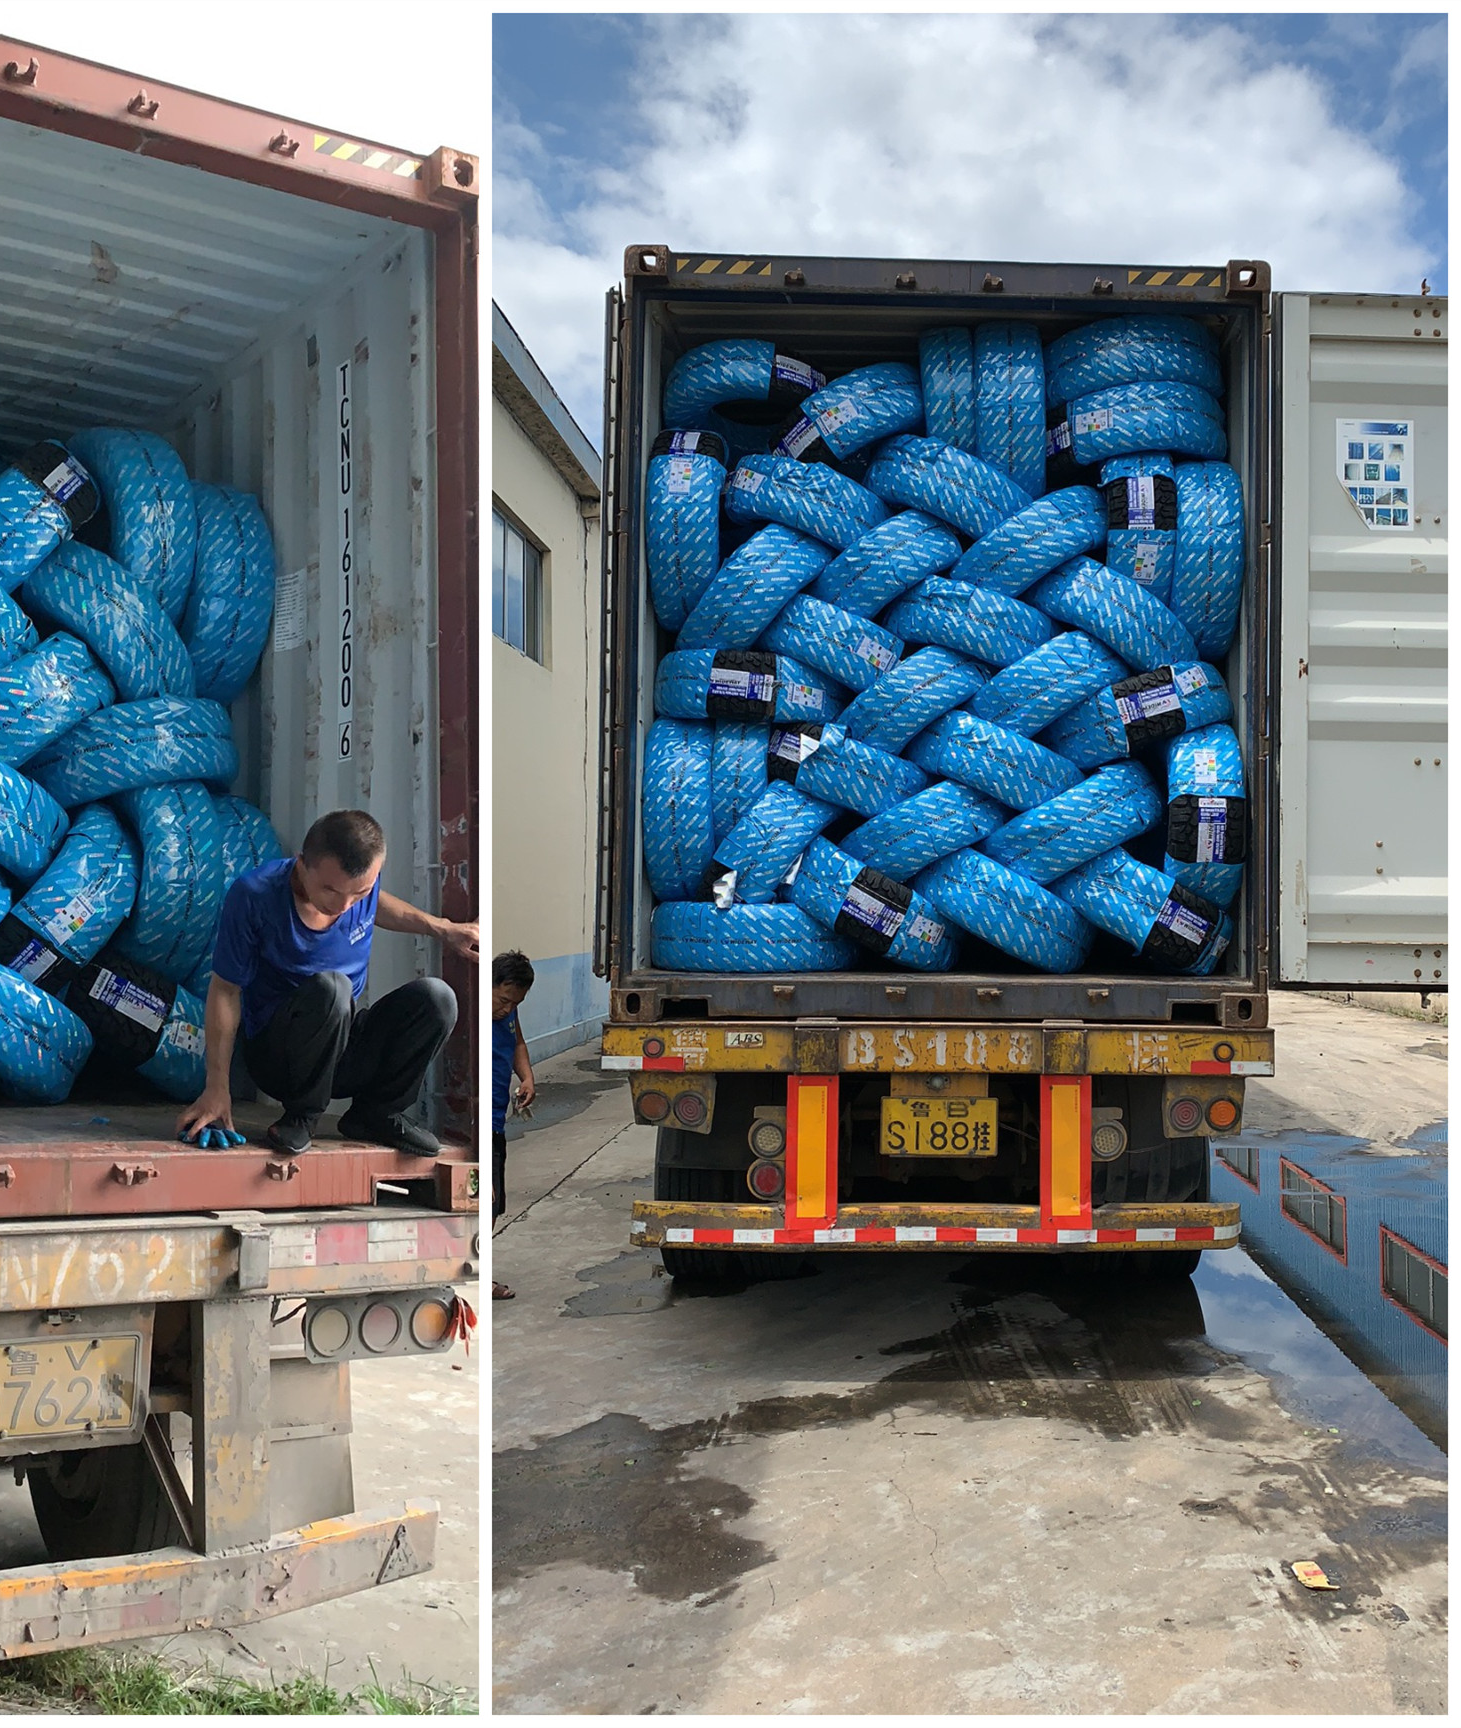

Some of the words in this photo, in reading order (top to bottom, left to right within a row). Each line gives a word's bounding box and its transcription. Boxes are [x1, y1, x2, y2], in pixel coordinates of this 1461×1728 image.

[340, 365, 350, 495] TCNU
[341, 508, 352, 709] 161200
[340, 724, 351, 757] 6
[730, 1032, 763, 1047] ABS
[909, 1100, 933, 1119] 鲁
[946, 1099, 970, 1118] B
[886, 1119, 992, 1152] S188挂
[64, 1342, 92, 1372] V
